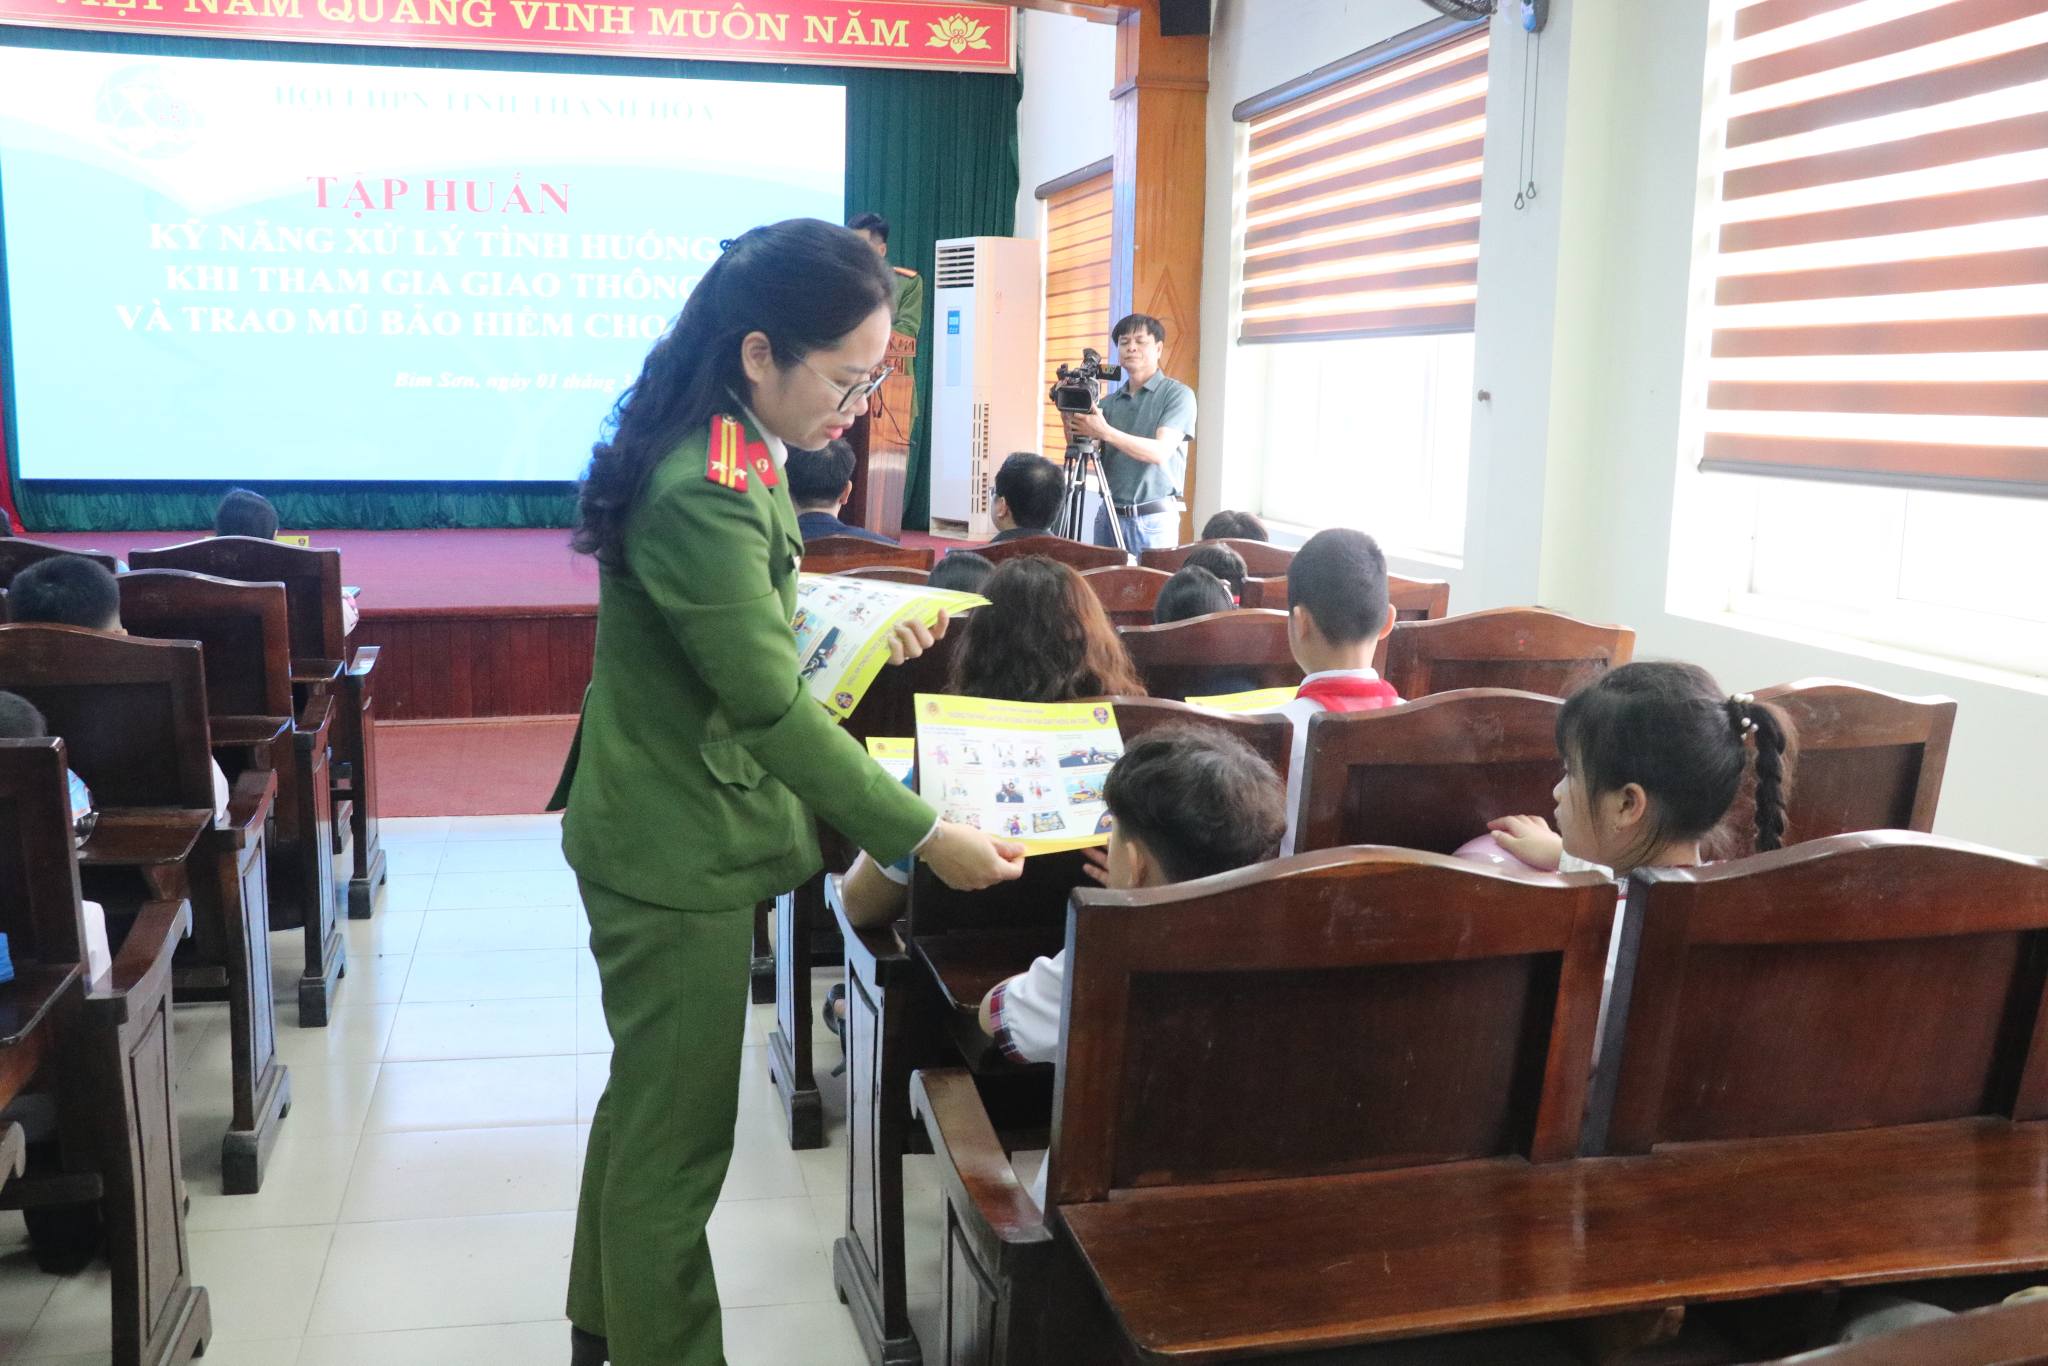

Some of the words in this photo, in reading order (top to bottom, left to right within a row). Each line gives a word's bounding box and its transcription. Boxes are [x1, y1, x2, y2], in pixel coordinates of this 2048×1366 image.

[316, 0, 497, 28] QUANG
[509, 0, 635, 34] VINH
[647, 3, 790, 41] MUÔN
[803, 9, 910, 48] NĂM
[149, 218, 208, 251] KỸ
[217, 219, 336, 253] NĂNG
[345, 221, 404, 255] XỬ
[413, 223, 465, 256] LÝ
[474, 225, 570, 259] TÌNH
[165, 264, 241, 292] KHI
[250, 265, 370, 294] THAM
[380, 267, 450, 296] GIA
[460, 270, 561, 298] GIAO
[115, 299, 173, 332] VÀ
[181, 305, 297, 334] TRAO
[306, 303, 369, 336] MŨ
[584, 311, 668, 340] CHO
